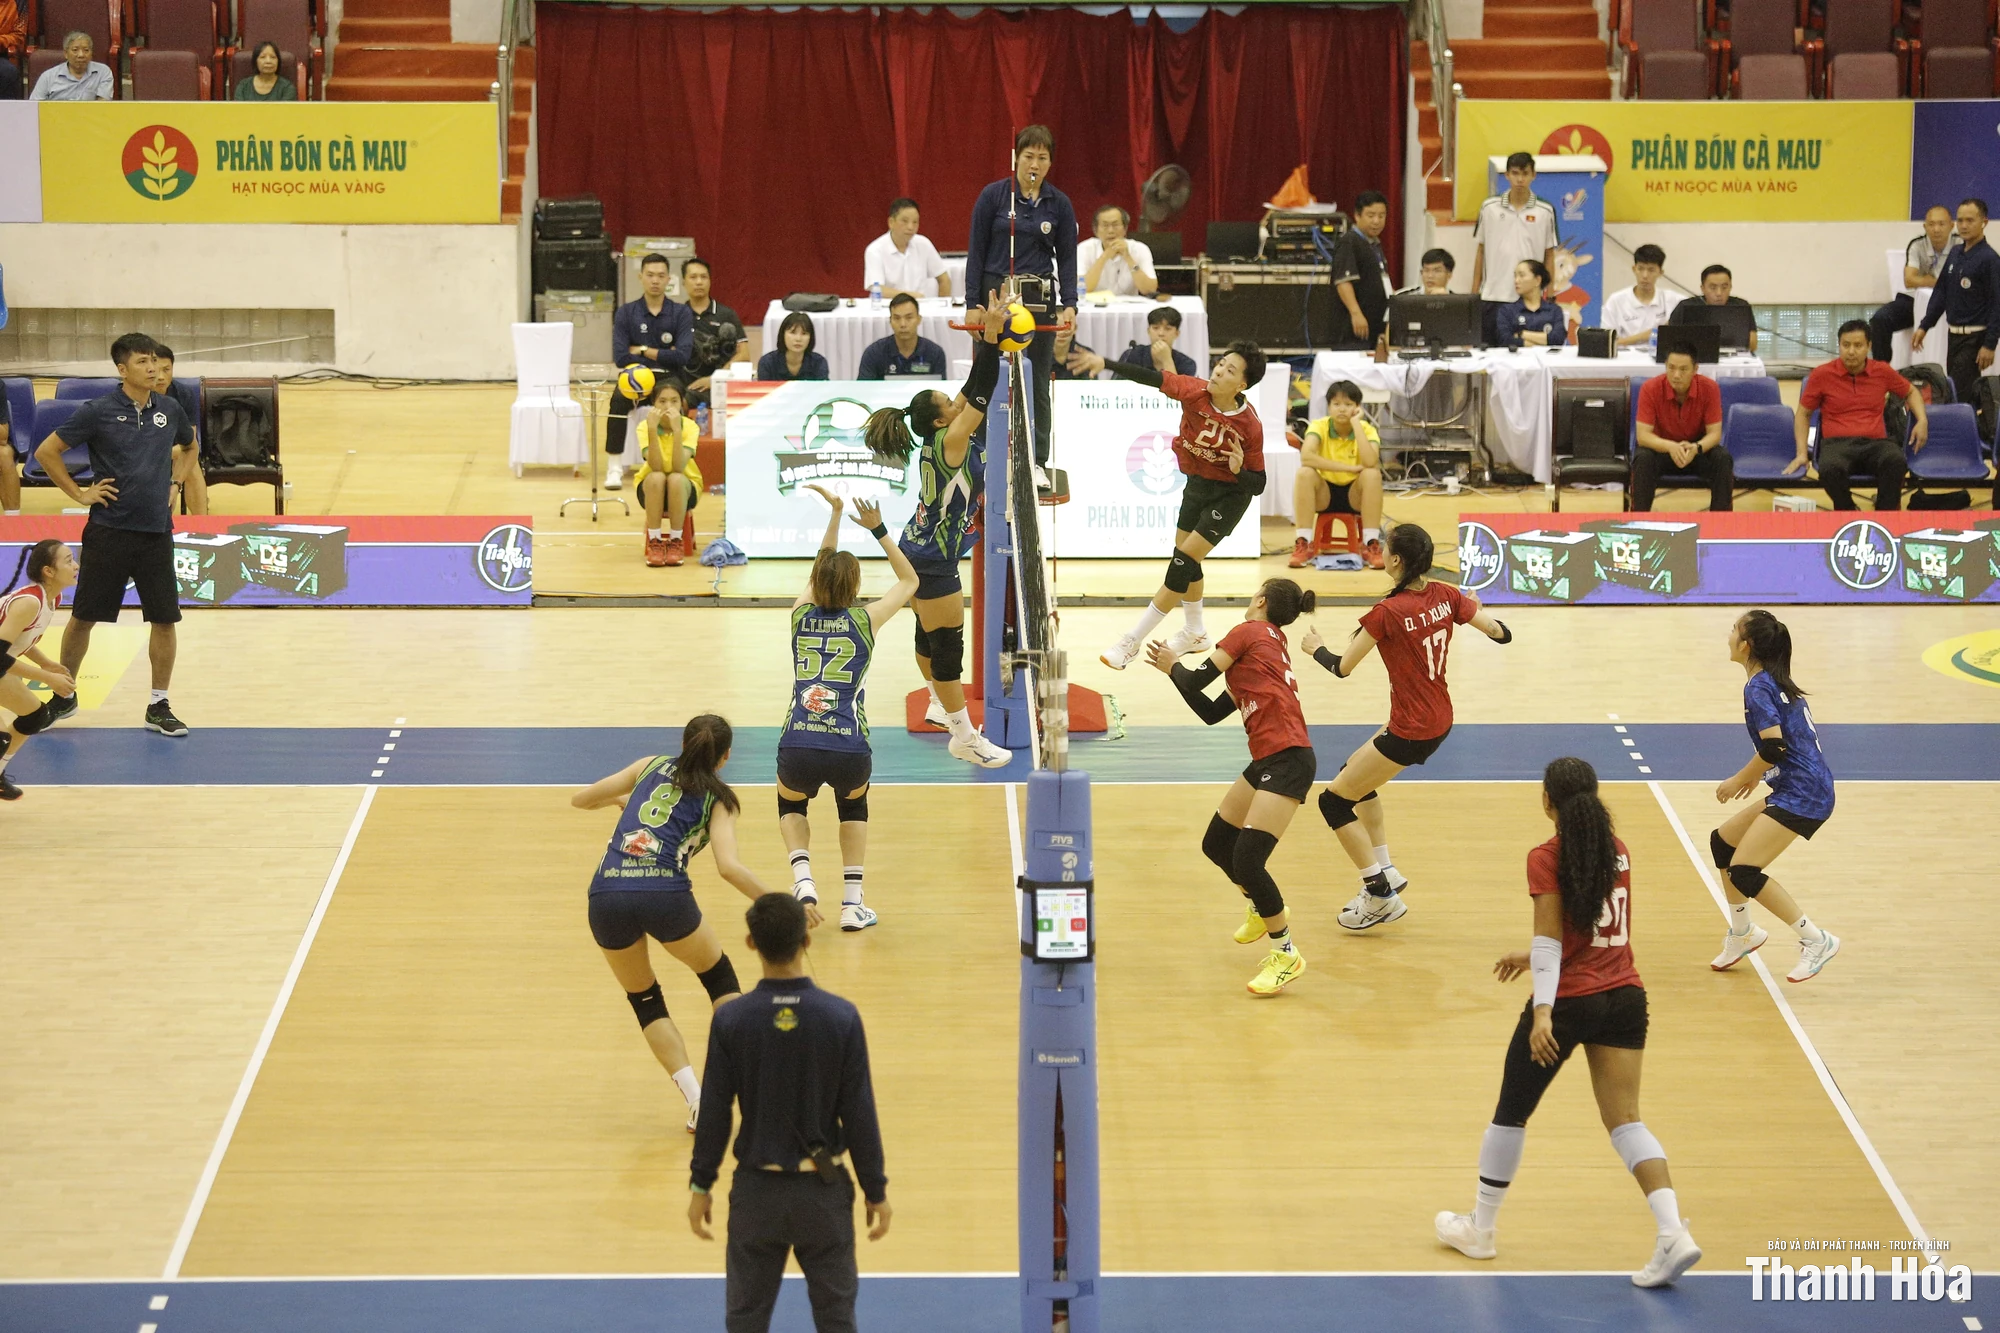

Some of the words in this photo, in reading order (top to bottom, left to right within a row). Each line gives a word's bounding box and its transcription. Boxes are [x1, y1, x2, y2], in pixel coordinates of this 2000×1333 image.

[216, 134, 273, 171] PHÂN
[280, 134, 322, 171] BÓN
[328, 134, 356, 171] CÀ
[363, 140, 407, 171] MAU
[1631, 133, 1688, 170] PHÂN
[1694, 133, 1736, 170] BÓN
[1743, 133, 1770, 170] CÀ
[1777, 139, 1822, 170] MAU
[232, 182, 257, 196] HẠT
[262, 182, 305, 196] NGỌC
[309, 180, 340, 194] MÙA
[345, 180, 385, 194] VÀNG
[1645, 181, 1670, 195] HẠT
[1674, 181, 1718, 195] NGỌC
[1722, 178, 1753, 193] MÙA
[1757, 179, 1798, 193] VÀNG
[260, 543, 288, 567] DG
[1526, 553, 1552, 573] DG
[1612, 541, 1640, 564] DG
[1920, 551, 1947, 571] DG
[1419, 612, 1430, 627] T.
[796, 636, 857, 684] 52
[1422, 628, 1448, 681] 17
[638, 783, 683, 828] 8
[1590, 887, 1629, 949] 20
